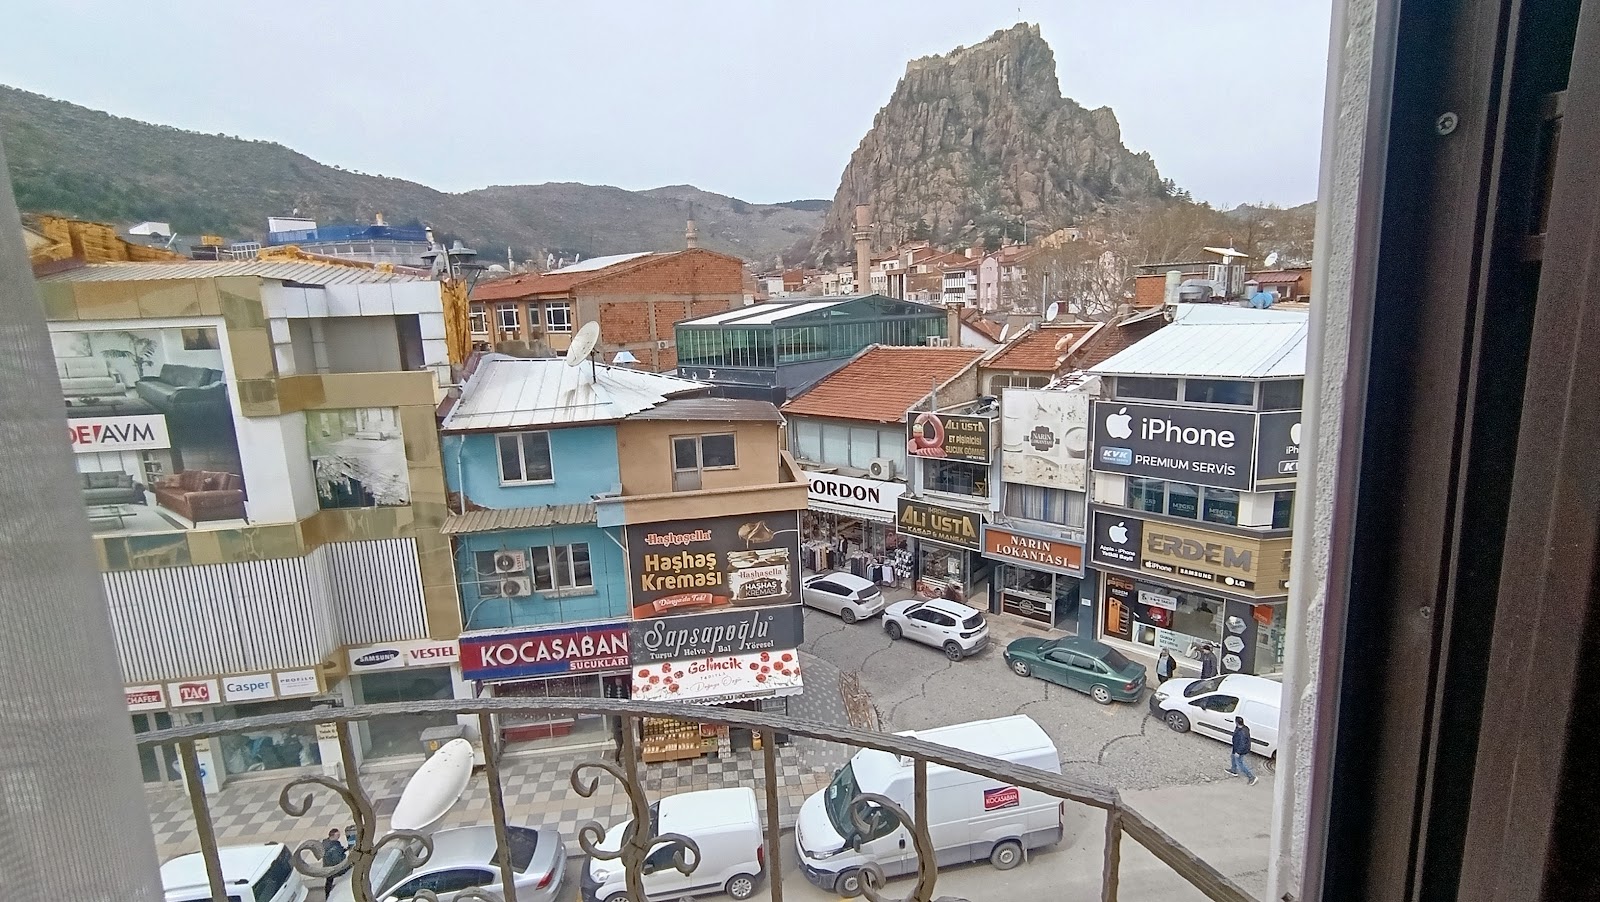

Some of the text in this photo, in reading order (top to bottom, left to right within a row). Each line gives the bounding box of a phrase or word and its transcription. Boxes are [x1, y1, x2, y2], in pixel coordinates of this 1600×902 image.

[101, 423, 155, 443] AVM
[961, 421, 986, 432] USTA
[1141, 417, 1235, 448] iPhone
[949, 435, 956, 443] ET
[945, 446, 964, 455] SUCUK
[1103, 450, 1128, 459] KVK
[1135, 454, 1235, 476] PREMIUM SERVİS
[1284, 463, 1299, 472] K
[931, 514, 977, 538] USTA
[907, 525, 932, 535] KASAP
[938, 532, 969, 545] MANGAL
[996, 544, 1068, 567] LOKANTASI
[1147, 532, 1252, 573] ERDEM
[644, 551, 717, 574] Haşhaş
[1151, 563, 1173, 573] iPhone
[641, 572, 722, 592] Kreması
[1180, 569, 1212, 580] SAMSUNG
[745, 581, 777, 590] HAŞHAŞ
[410, 646, 457, 659] VESTEL
[481, 632, 629, 667] KOCAŞABAN
[650, 640, 775, 660] Turşu Helva Bal Yöresel
[359, 653, 395, 663] SAMSUNG
[570, 656, 629, 671] SUCUKLARI
[688, 657, 743, 674] Gelincik
[181, 686, 208, 701] TAÇ
[227, 681, 270, 692] Casper
[127, 695, 159, 704] CHAFER
